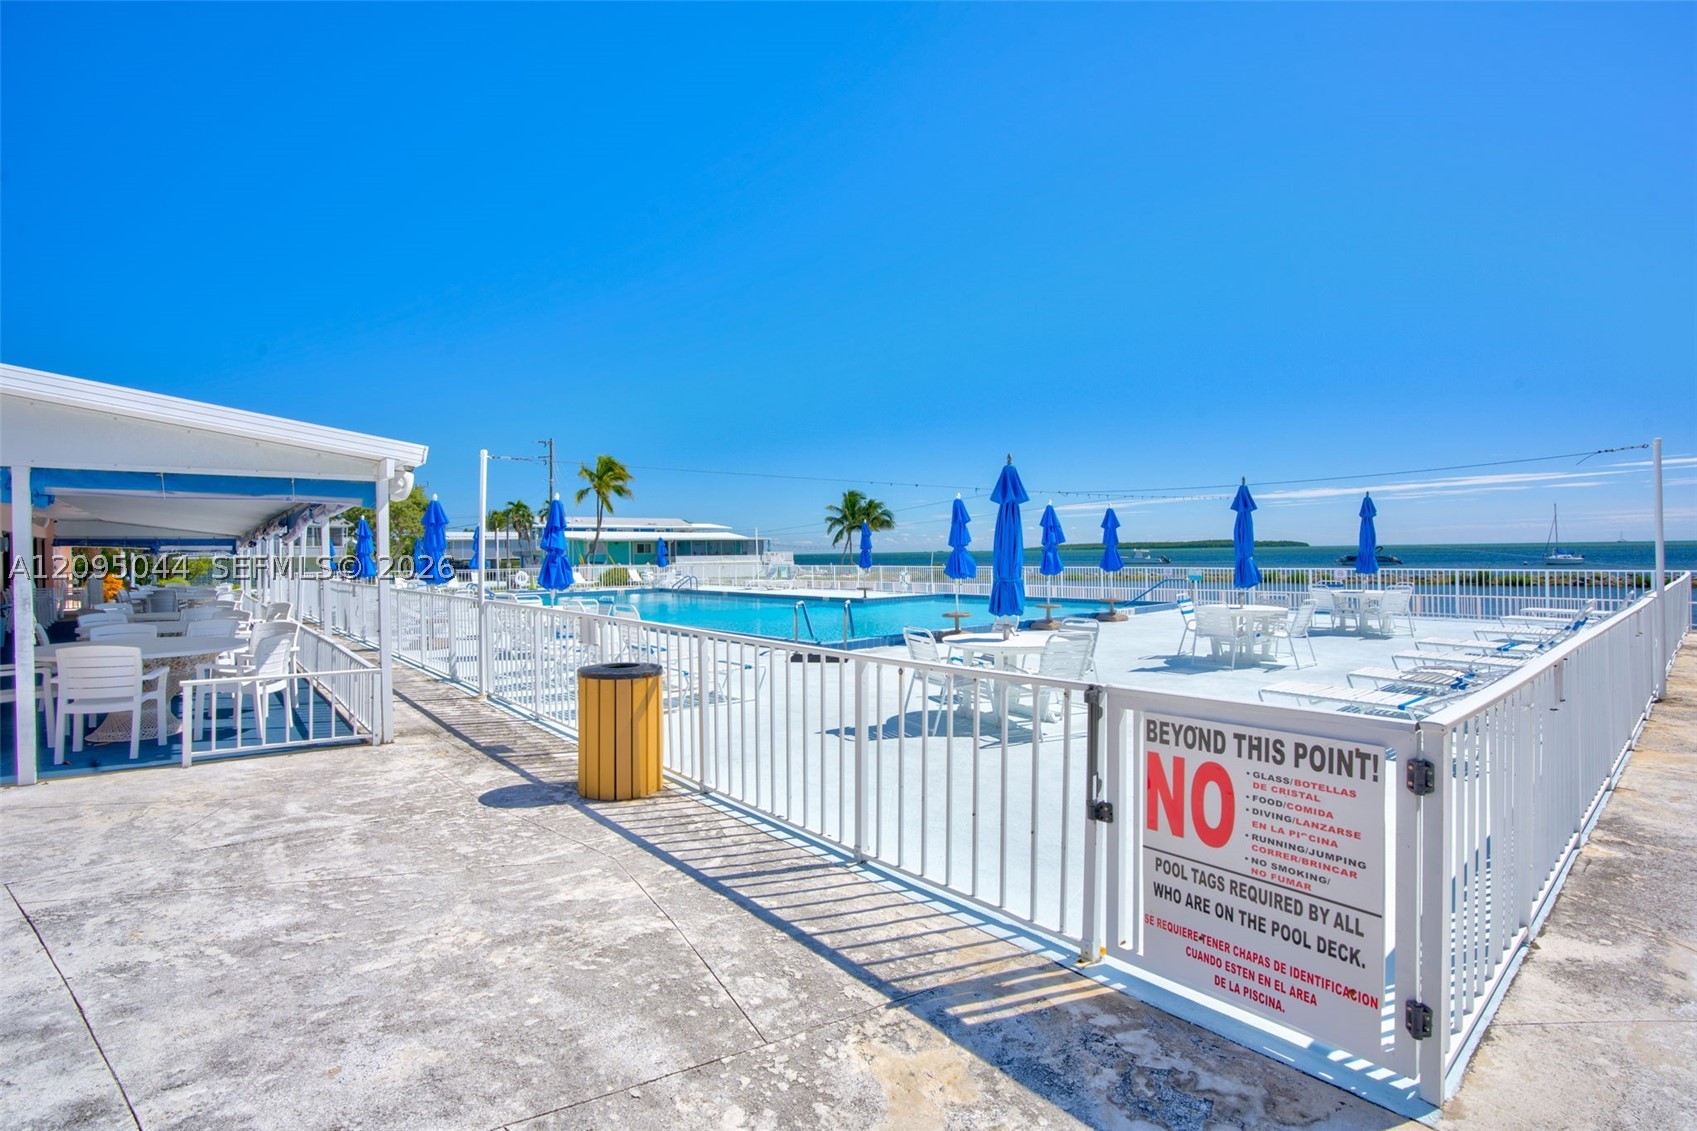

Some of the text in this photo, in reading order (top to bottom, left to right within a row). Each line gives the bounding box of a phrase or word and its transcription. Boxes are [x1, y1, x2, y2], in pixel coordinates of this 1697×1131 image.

[1146, 719, 1379, 782] BEYOND THIS POINT!
[1146, 751, 1235, 848] NO
[1253, 771, 1357, 798] GLASS/BOTELLAS
[1253, 782, 1320, 802] DE CRISTAL
[1252, 795, 1334, 819] FOOD/COMIDA
[1252, 808, 1362, 840] DIVING/LANZARSE
[1252, 821, 1267, 831] EN
[1271, 826, 1285, 835] LA
[1251, 833, 1367, 869] RUNNING/JUMPING
[1251, 844, 1358, 879] CORRER/BRINCAR
[1251, 857, 1331, 885] NO SMOKING/
[1251, 868, 1312, 891] NO FUMAR
[1155, 857, 1364, 937] POOL TAGS REQUIRED BY ALL
[1153, 881, 1366, 969] WHO ARE ON THE POOL DECK.
[1144, 913, 1379, 1010] SE REQUIERE TENER CHAPAS DE IDENTIFICACION
[1185, 946, 1317, 1006] CUANDO ESTEN EN EL AREA
[1214, 974, 1285, 1013] DE LA PISCINA.
